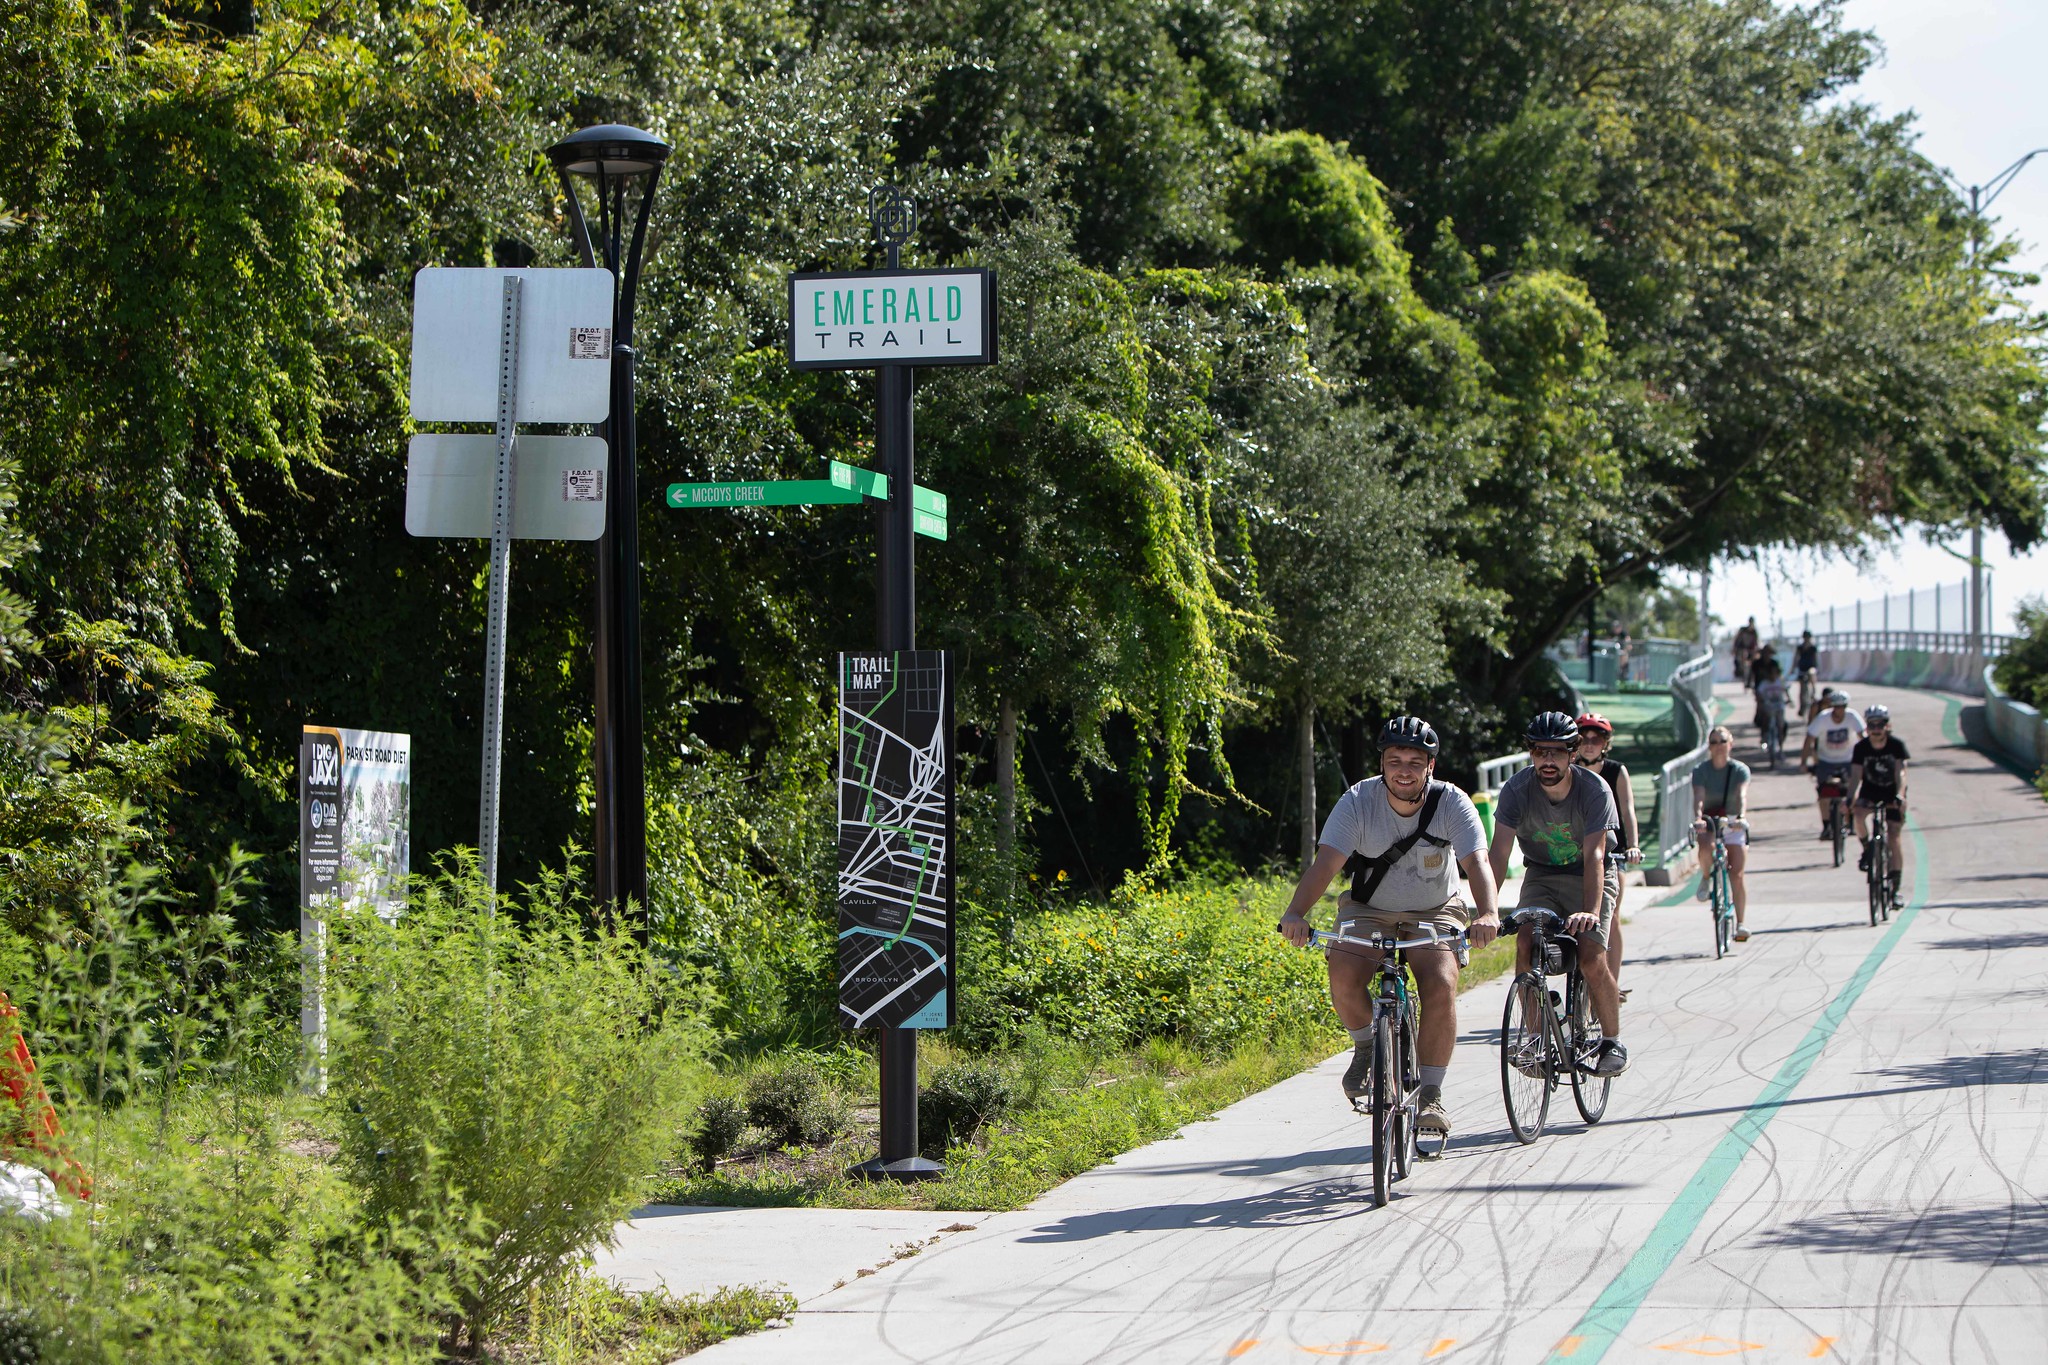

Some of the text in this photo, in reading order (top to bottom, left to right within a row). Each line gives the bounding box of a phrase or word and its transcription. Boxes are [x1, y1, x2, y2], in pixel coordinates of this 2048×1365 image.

[814, 285, 962, 327] EMERALD
[814, 328, 962, 349] TRAIL
[691, 485, 765, 503] MCCOYS CREEK
[852, 657, 891, 673] TRAIL
[853, 673, 882, 690] MAP
[312, 743, 332, 761] I DIG
[346, 746, 406, 764] PARK ST. ROAD DIET
